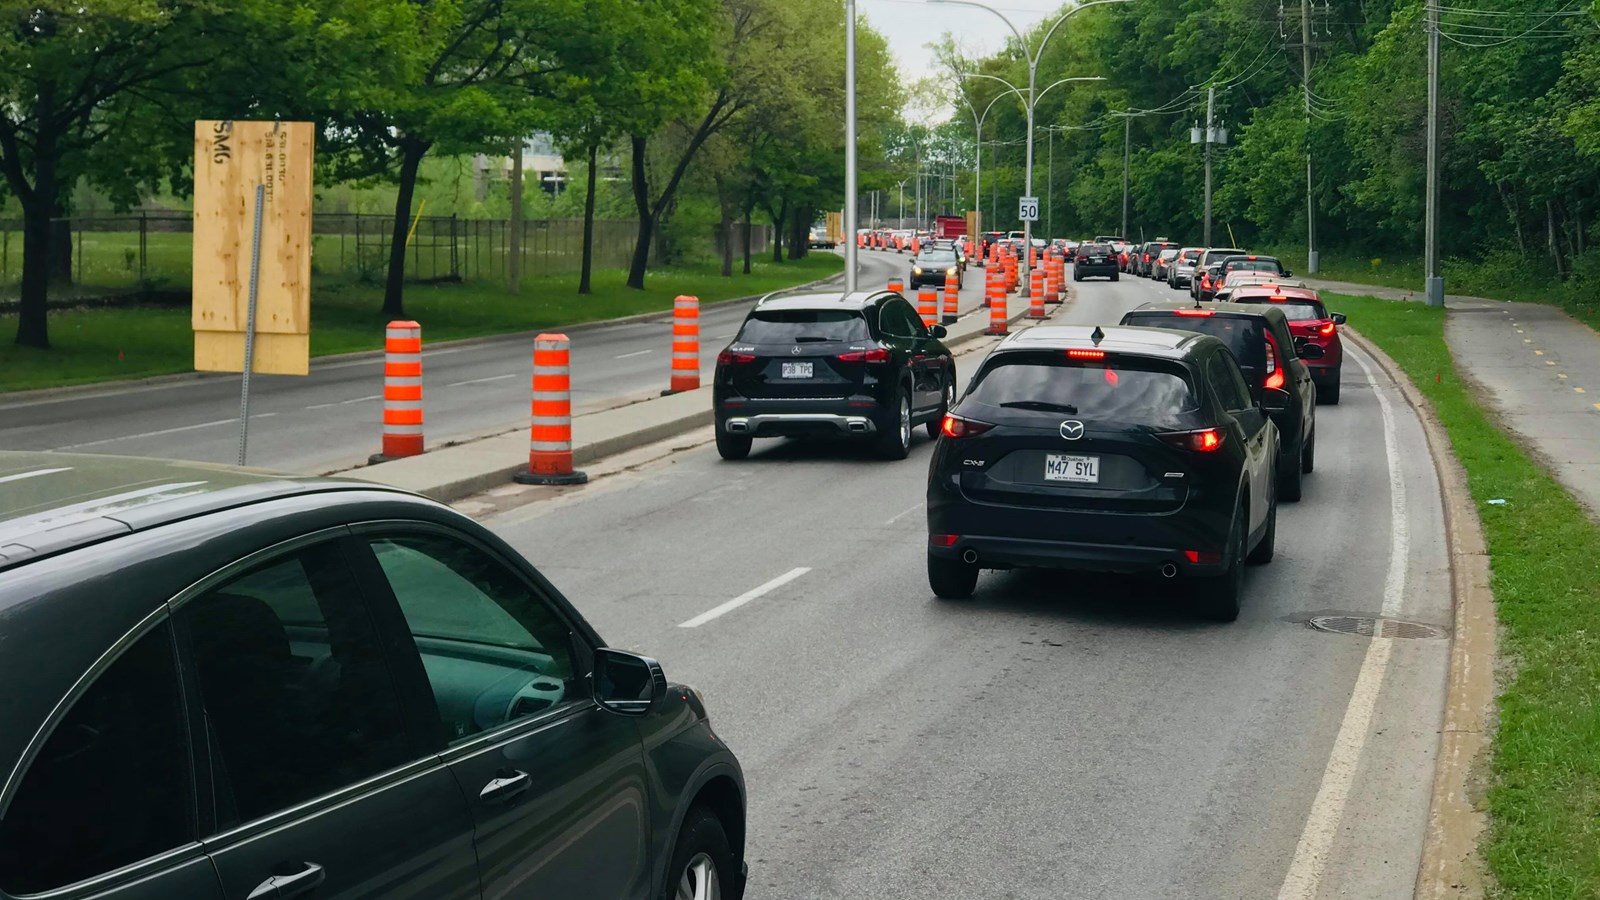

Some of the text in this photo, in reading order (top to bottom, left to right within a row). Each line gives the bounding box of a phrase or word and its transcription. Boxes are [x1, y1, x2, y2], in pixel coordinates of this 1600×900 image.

[1021, 205, 1037, 218] 50
[783, 365, 814, 375] P38 TPC
[1047, 460, 1097, 477] M47 SYL
